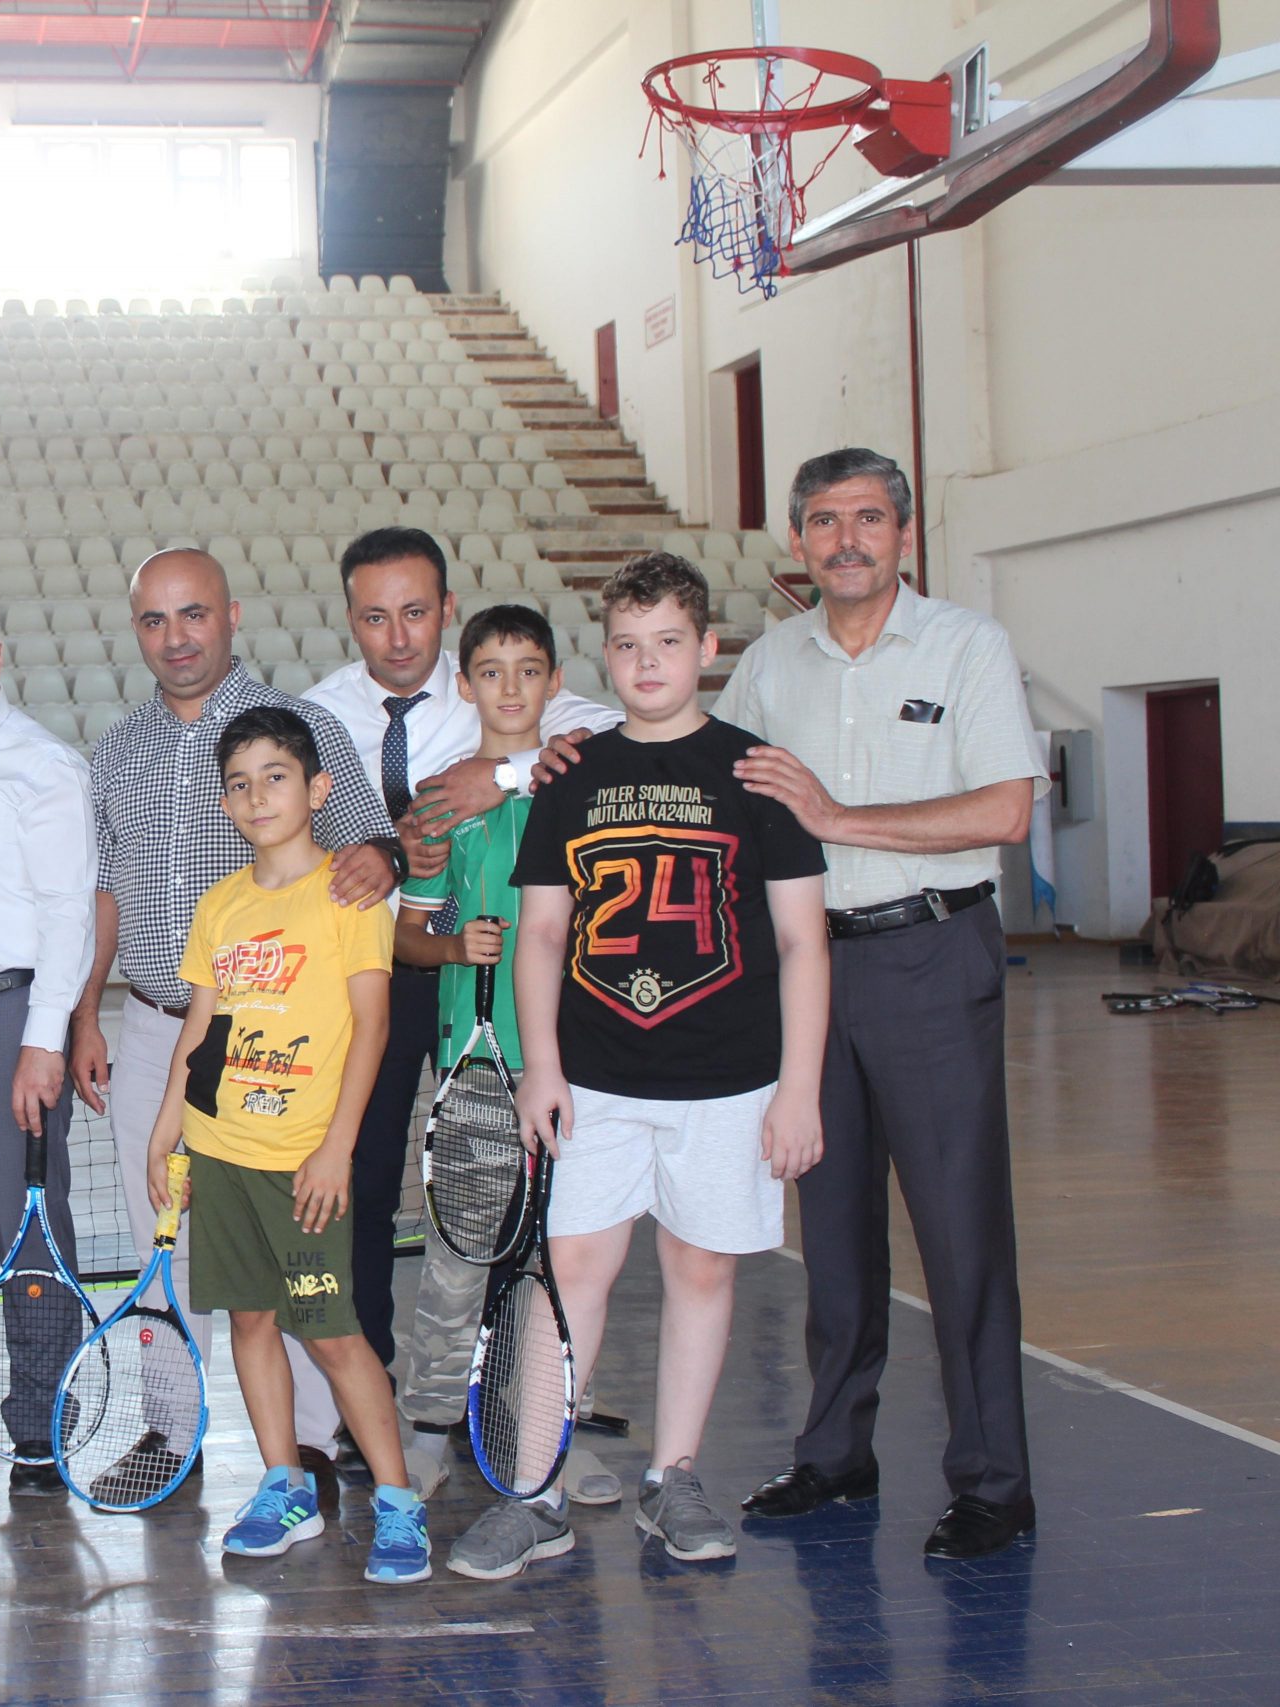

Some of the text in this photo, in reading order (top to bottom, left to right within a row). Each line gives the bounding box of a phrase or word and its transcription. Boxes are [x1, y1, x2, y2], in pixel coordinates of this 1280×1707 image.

[638, 784, 701, 804] SONUNDA
[587, 801, 646, 828] MUTLAKA
[586, 854, 715, 956] 24
[265, 1035, 310, 1078] BEST
[287, 1251, 326, 1267] LIVE
